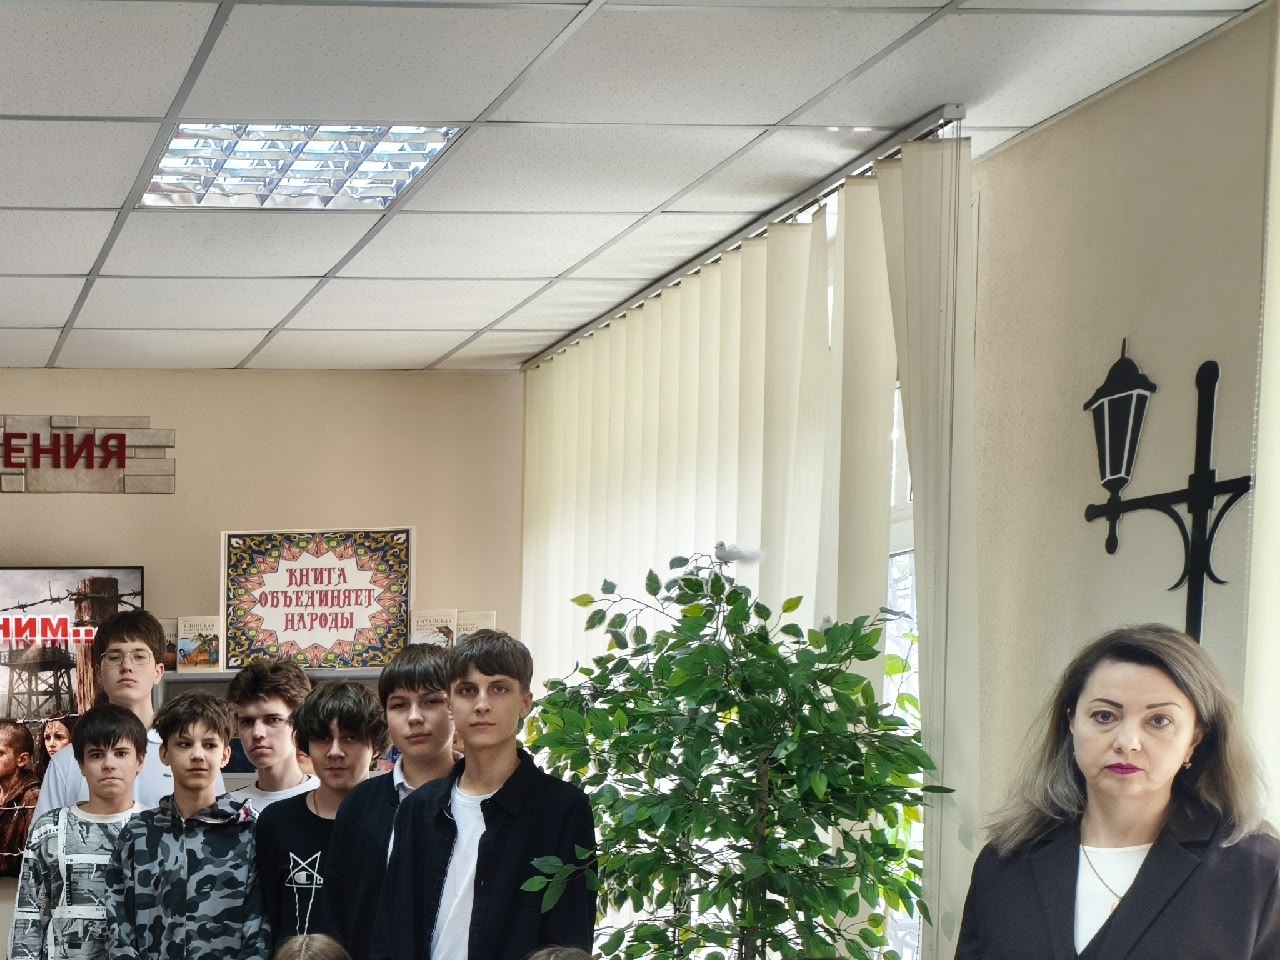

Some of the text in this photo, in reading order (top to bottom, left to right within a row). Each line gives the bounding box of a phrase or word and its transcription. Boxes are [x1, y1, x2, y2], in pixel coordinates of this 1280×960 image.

[286, 567, 348, 587] КНИГА
[258, 588, 375, 610] ОБЪЕДИНЯЕТ
[283, 611, 354, 632] НАРОДЫ
